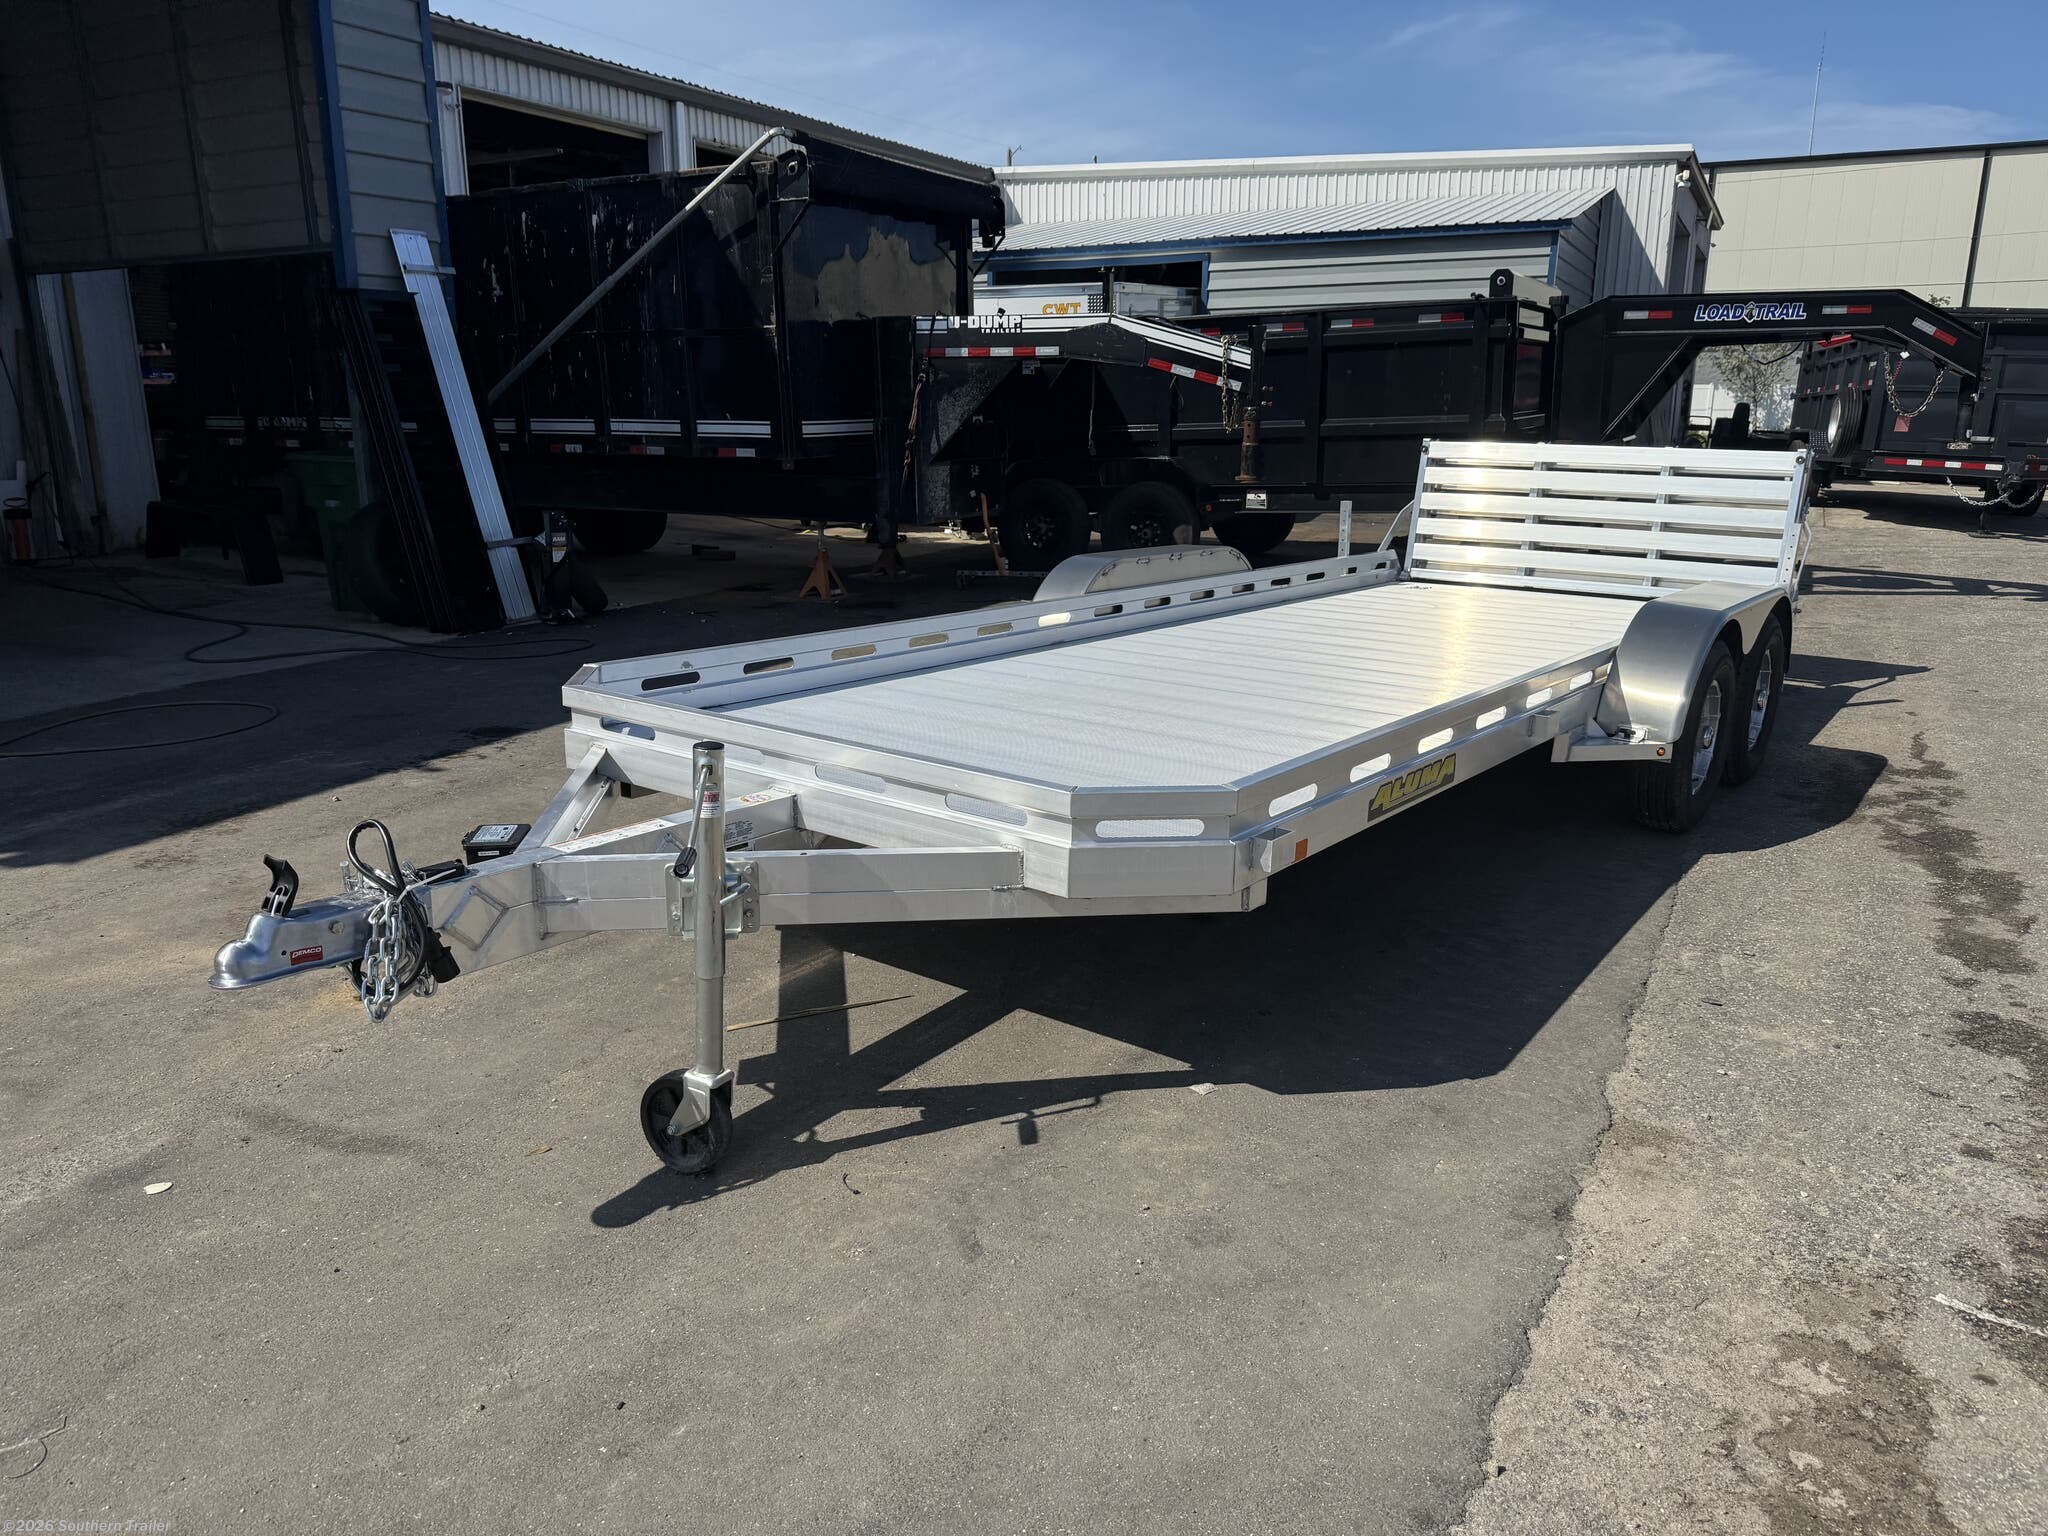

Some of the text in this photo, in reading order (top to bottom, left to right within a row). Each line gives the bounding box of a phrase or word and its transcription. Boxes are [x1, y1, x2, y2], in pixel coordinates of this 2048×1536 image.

[1042, 302, 1081, 315] CWT
[1694, 302, 1807, 321] LOAD TRAIL
[1370, 753, 1456, 811] ALUMA
[291, 947, 322, 958] DEMCO
